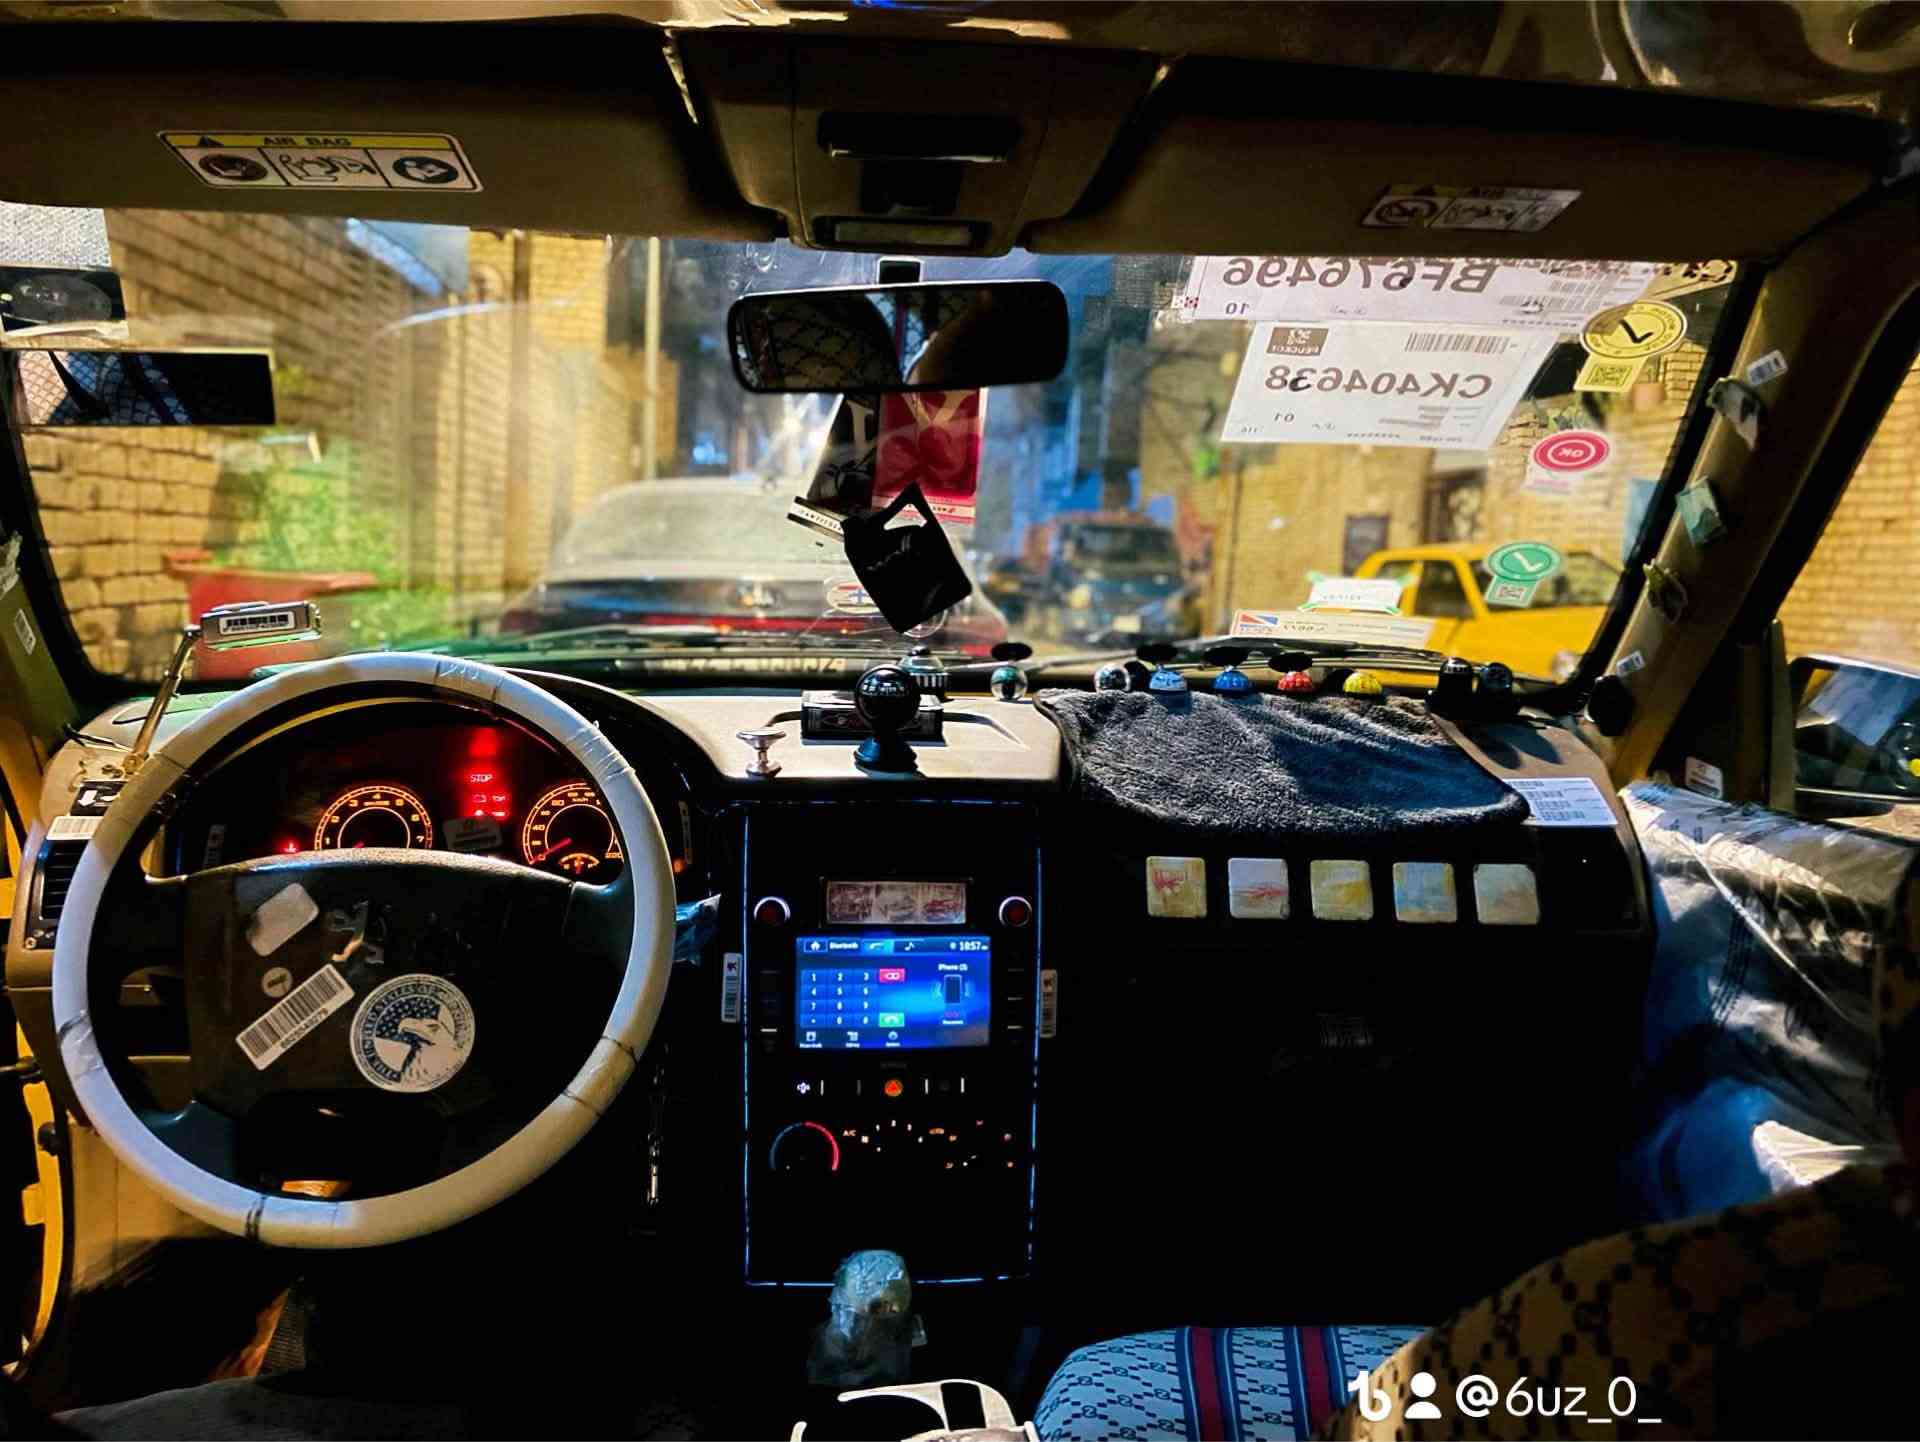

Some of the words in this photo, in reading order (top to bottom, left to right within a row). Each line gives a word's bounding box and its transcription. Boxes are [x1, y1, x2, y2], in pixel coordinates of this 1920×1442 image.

[263, 136, 295, 146] AIR
[304, 136, 352, 146] BAG
[470, 773, 493, 782] STOP
